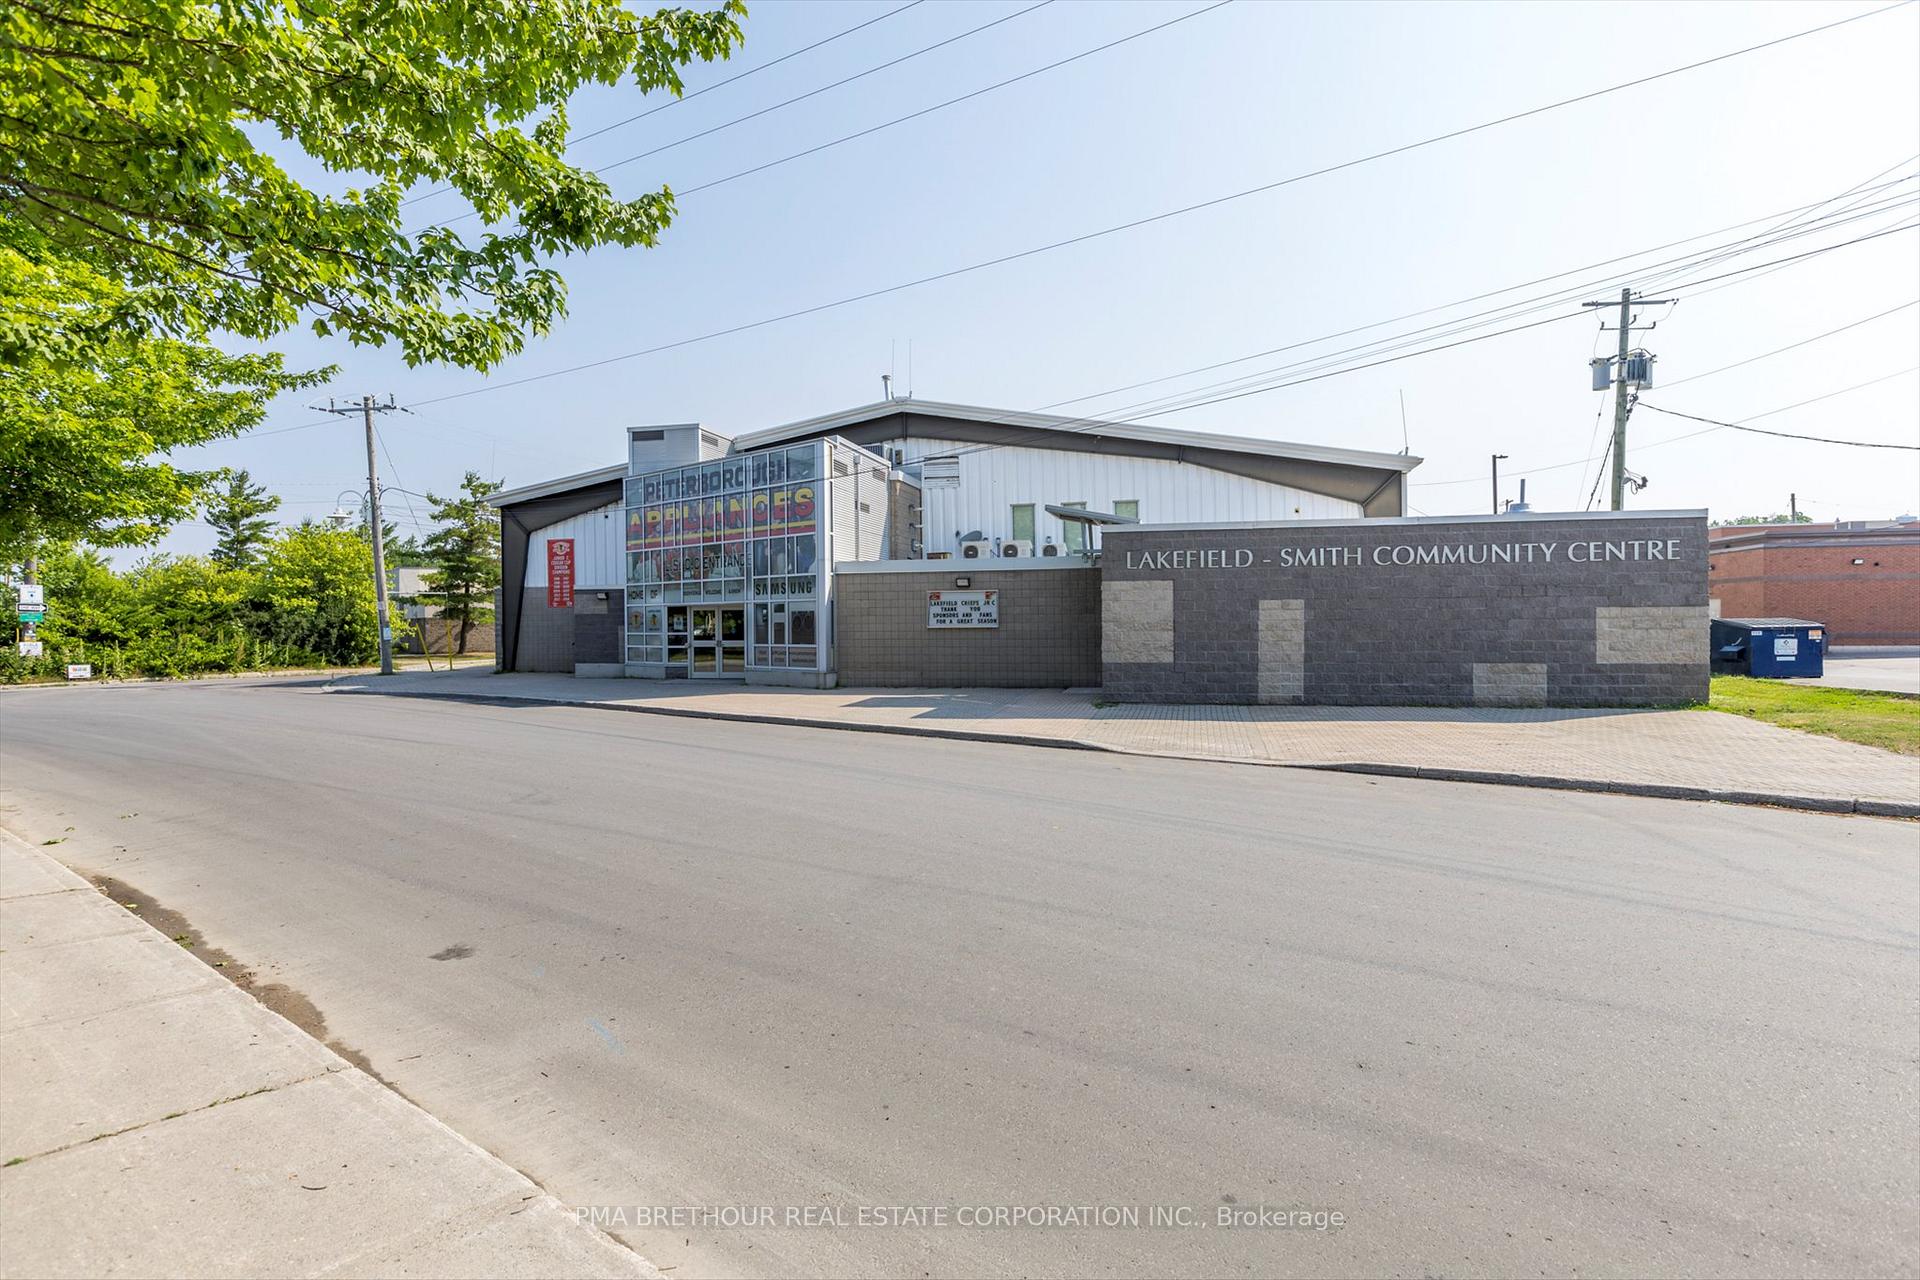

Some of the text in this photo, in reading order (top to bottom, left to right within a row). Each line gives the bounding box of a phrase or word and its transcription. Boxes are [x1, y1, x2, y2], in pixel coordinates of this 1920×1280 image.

[645, 458, 789, 501] PETERBOROUGH
[629, 487, 815, 535] APPLIANCES
[1126, 549, 1253, 569] LAKEFIELD
[1280, 547, 1362, 567] SMITH
[1372, 543, 1557, 566] COMMUNITY
[1567, 540, 1681, 563] CENTRE
[628, 590, 644, 600] HOME
[755, 581, 812, 596] SAMSUNG
